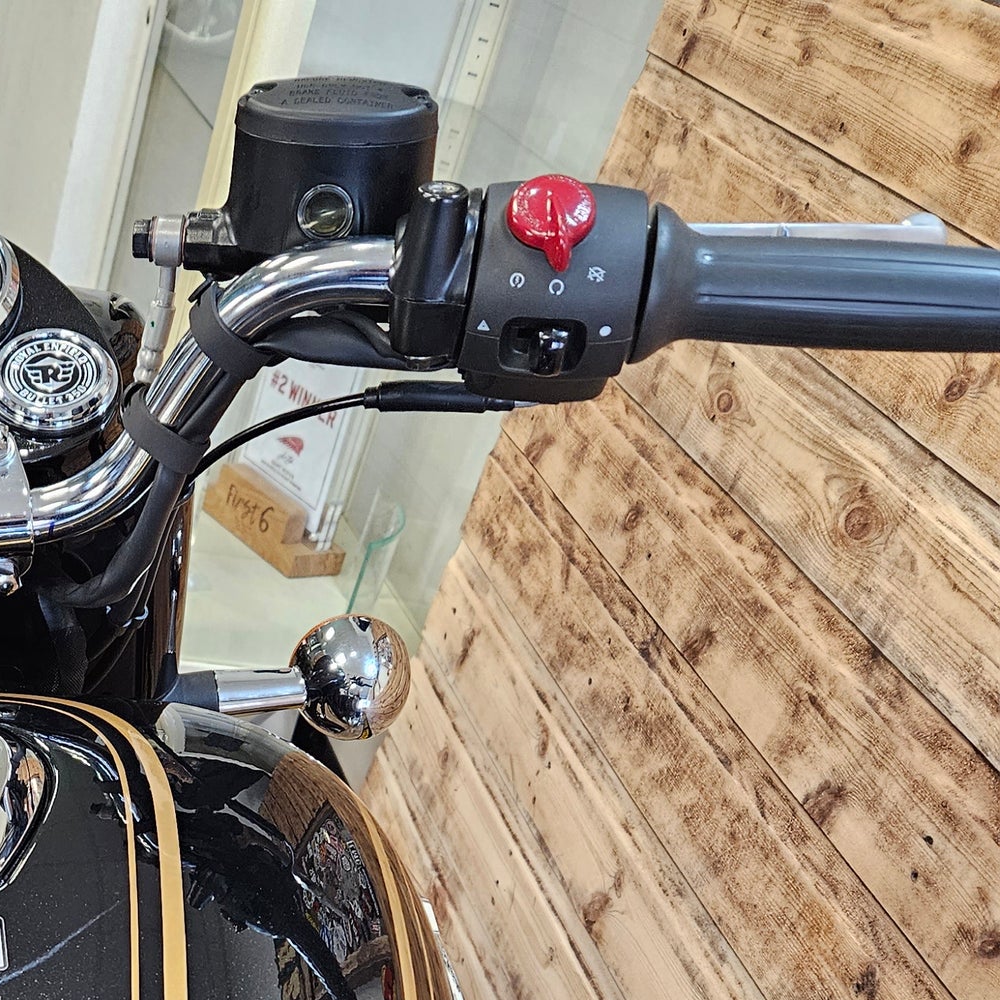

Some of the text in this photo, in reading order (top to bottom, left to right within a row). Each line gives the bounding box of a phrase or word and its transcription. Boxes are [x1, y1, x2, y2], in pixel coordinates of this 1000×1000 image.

[337, 97, 393, 109] CONTAINER
[11, 342, 89, 370] ROYAL ENFIELD
[19, 384, 88, 405] BULLET 350
[259, 506, 274, 532] 6
